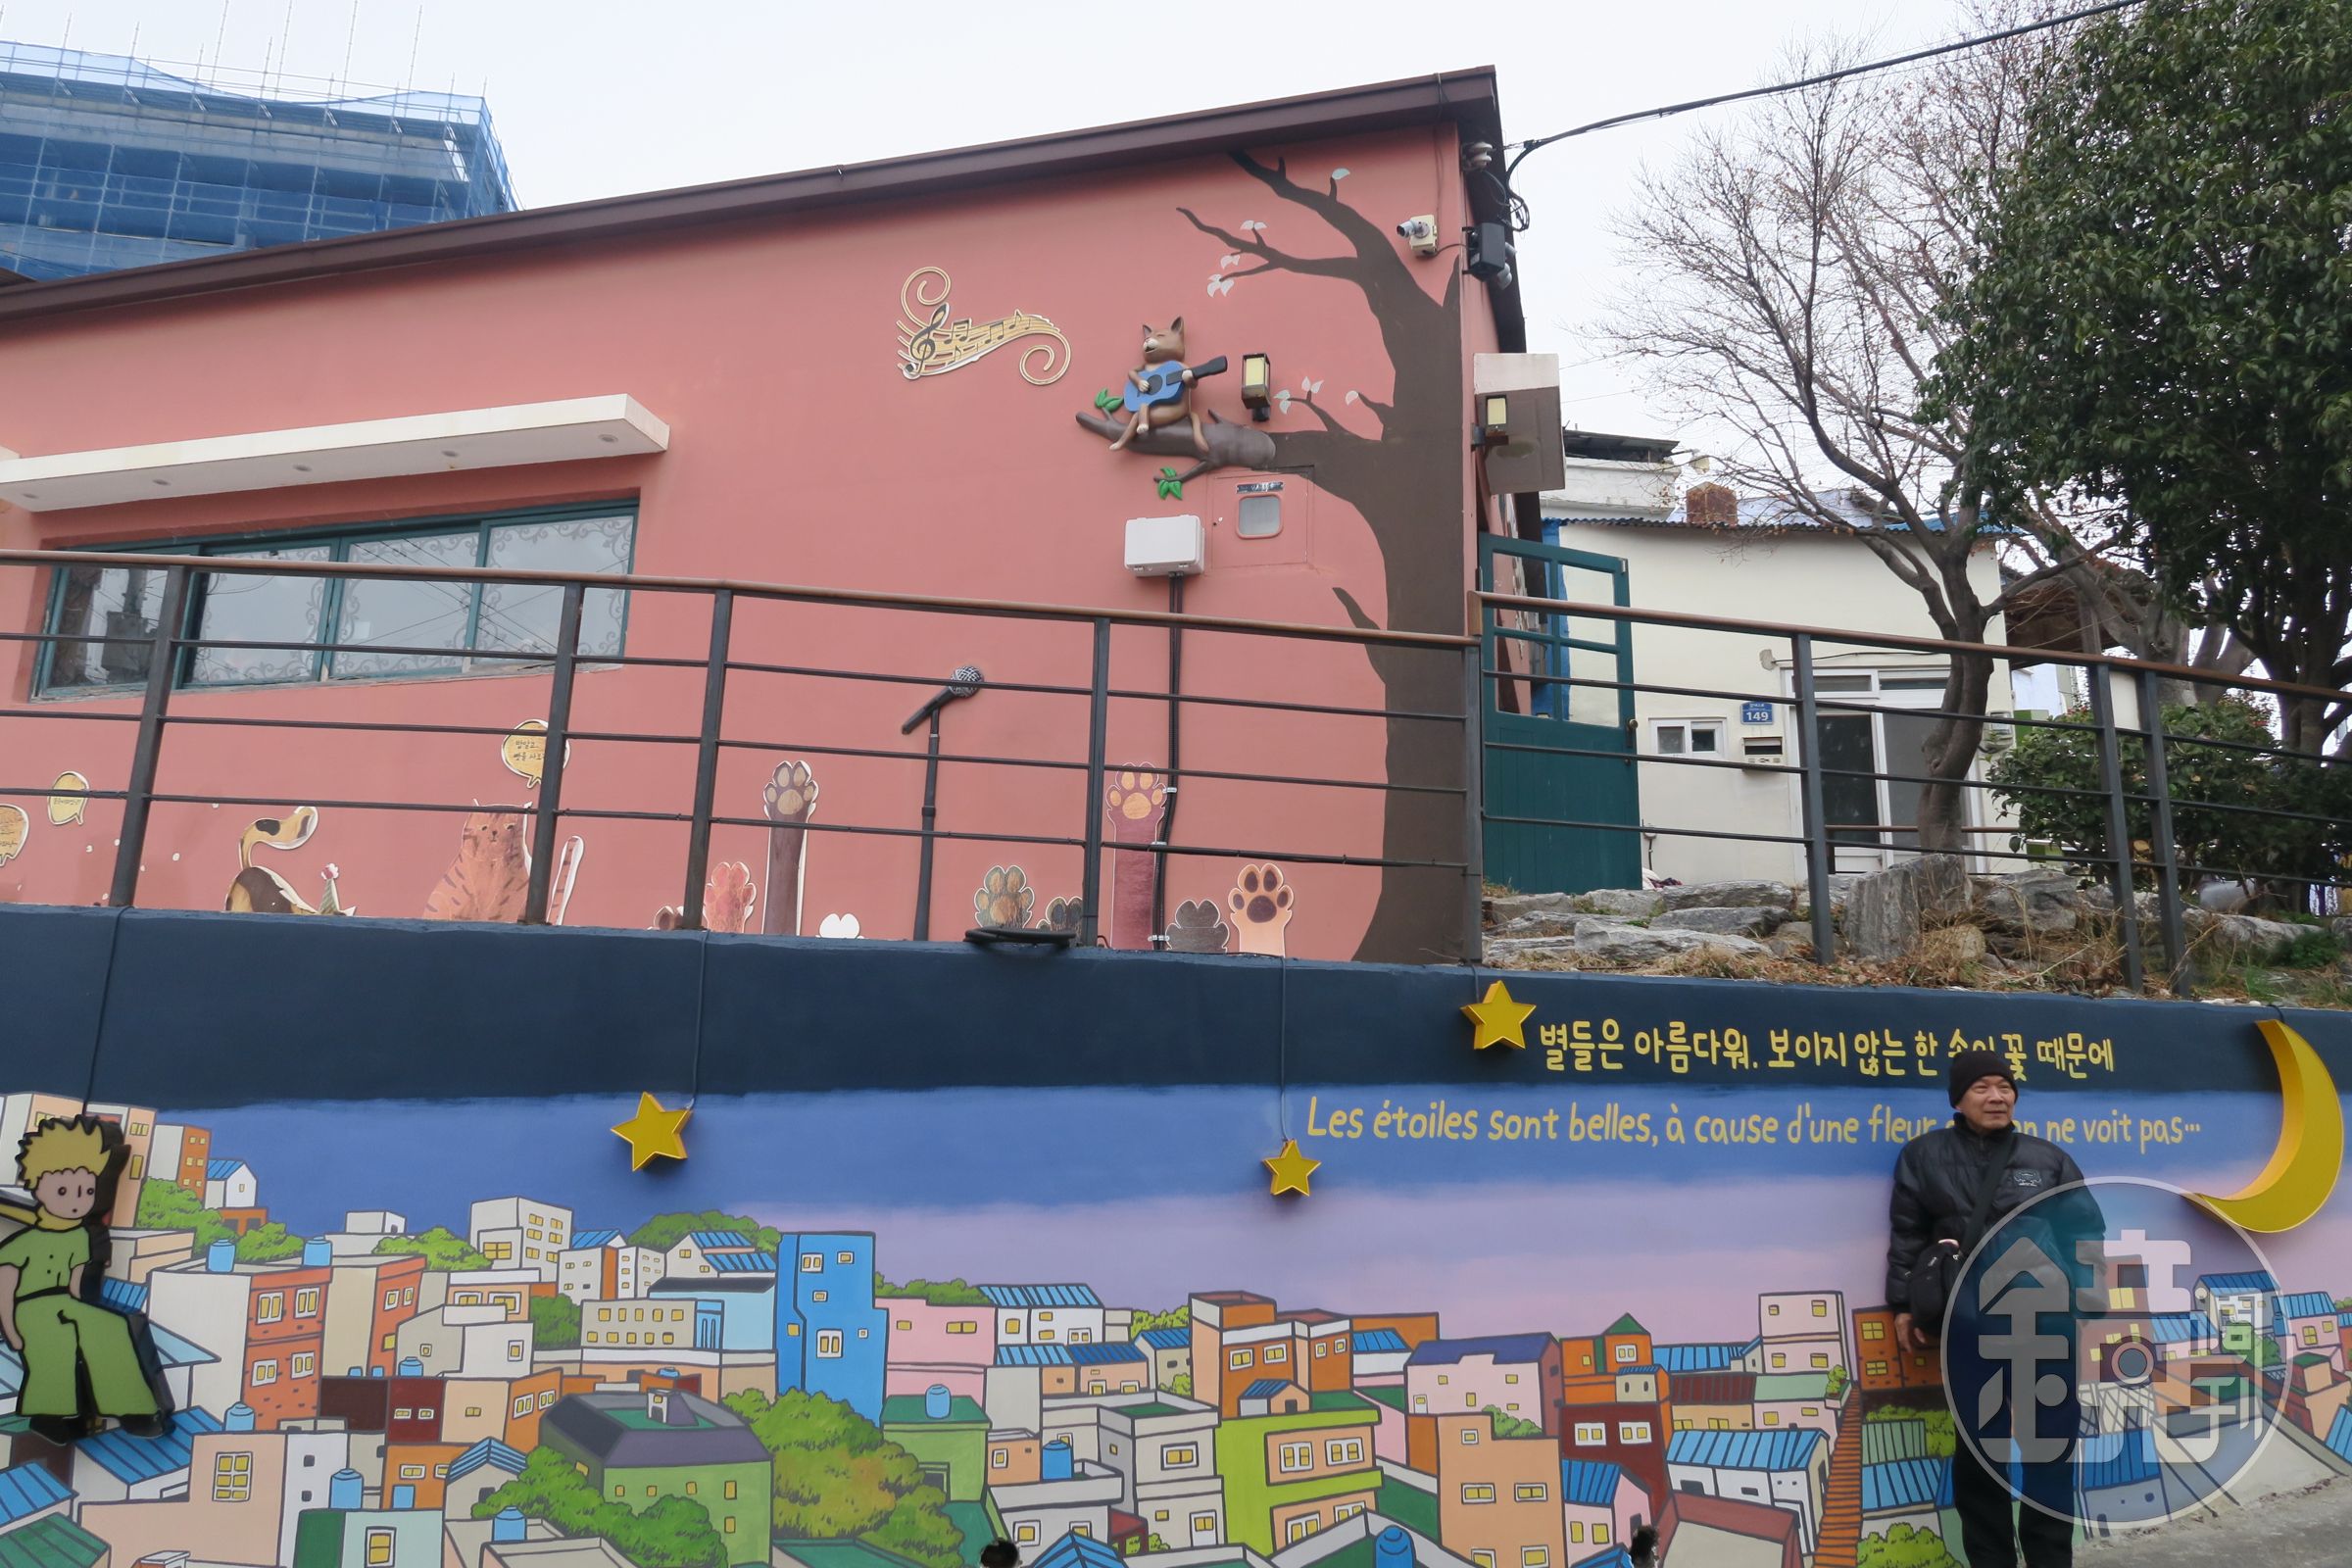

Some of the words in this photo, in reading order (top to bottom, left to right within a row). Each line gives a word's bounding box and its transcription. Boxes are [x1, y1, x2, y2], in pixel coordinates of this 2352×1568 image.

[1746, 711, 1769, 721] 149
[1540, 1018, 1625, 1071] 별들은
[1634, 1020, 1758, 1074] 아름다워.
[1768, 1028, 1846, 1068] 보이지
[1854, 1028, 1906, 1077] 않는
[1914, 1030, 1938, 1076] 한
[2001, 1033, 2028, 1082] 꽃
[2036, 1032, 2114, 1079] 때문에
[1307, 1096, 1364, 1139] Les
[1373, 1100, 1479, 1140] étoiles
[1488, 1108, 1559, 1141] sont
[1569, 1102, 1658, 1147] belles,
[1666, 1102, 1686, 1144] à
[1694, 1114, 1779, 1145] cause
[1787, 1102, 1860, 1144] d'une
[1868, 1103, 1936, 1144] fleur
[2046, 1117, 2076, 1144] ne
[2082, 1109, 2132, 1143] voit
